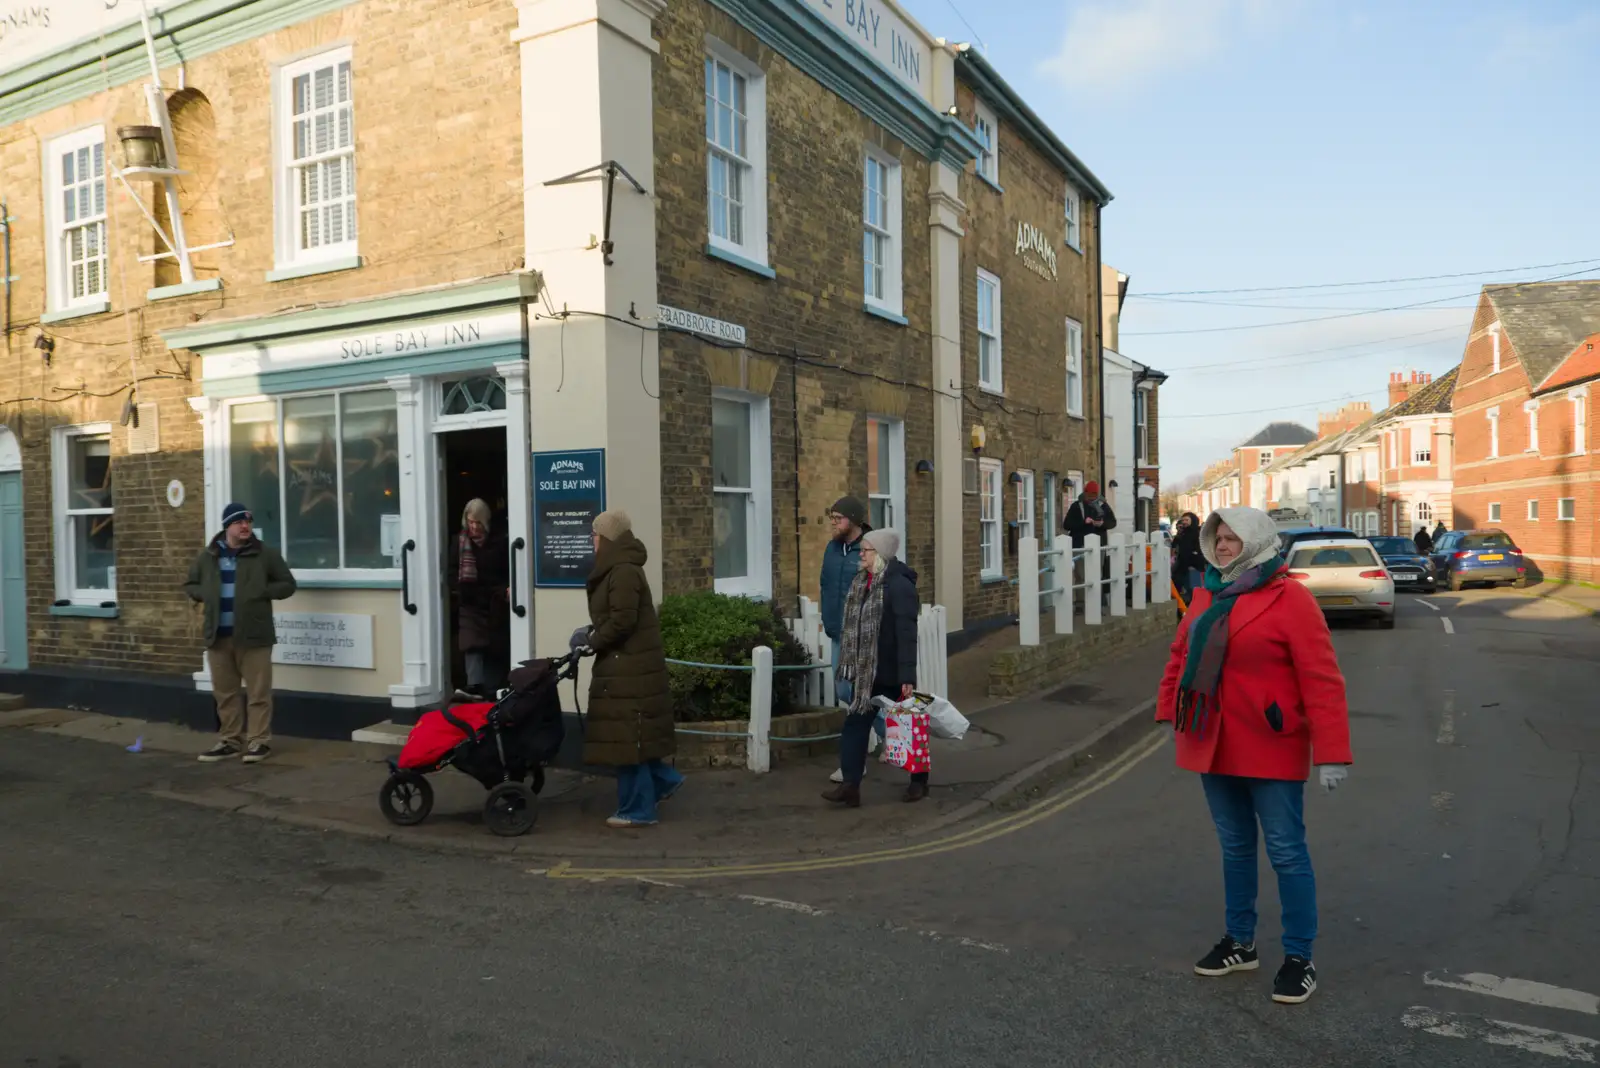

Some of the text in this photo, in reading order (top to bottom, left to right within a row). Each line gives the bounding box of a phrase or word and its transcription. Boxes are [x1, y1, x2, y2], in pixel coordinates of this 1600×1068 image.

[846, 0, 919, 83] BAY INN
[1015, 220, 1058, 281] ADNAMS
[657, 305, 742, 340] TRADBROKE ROAD
[341, 322, 481, 359] SOLE BAY INN
[550, 460, 584, 473] ADNAMS
[539, 479, 596, 490] SOLE BAY INN
[310, 618, 336, 631] beers
[337, 619, 346, 631] &
[290, 632, 322, 646] crafted
[325, 635, 354, 650] spirits
[282, 648, 335, 662] served here
